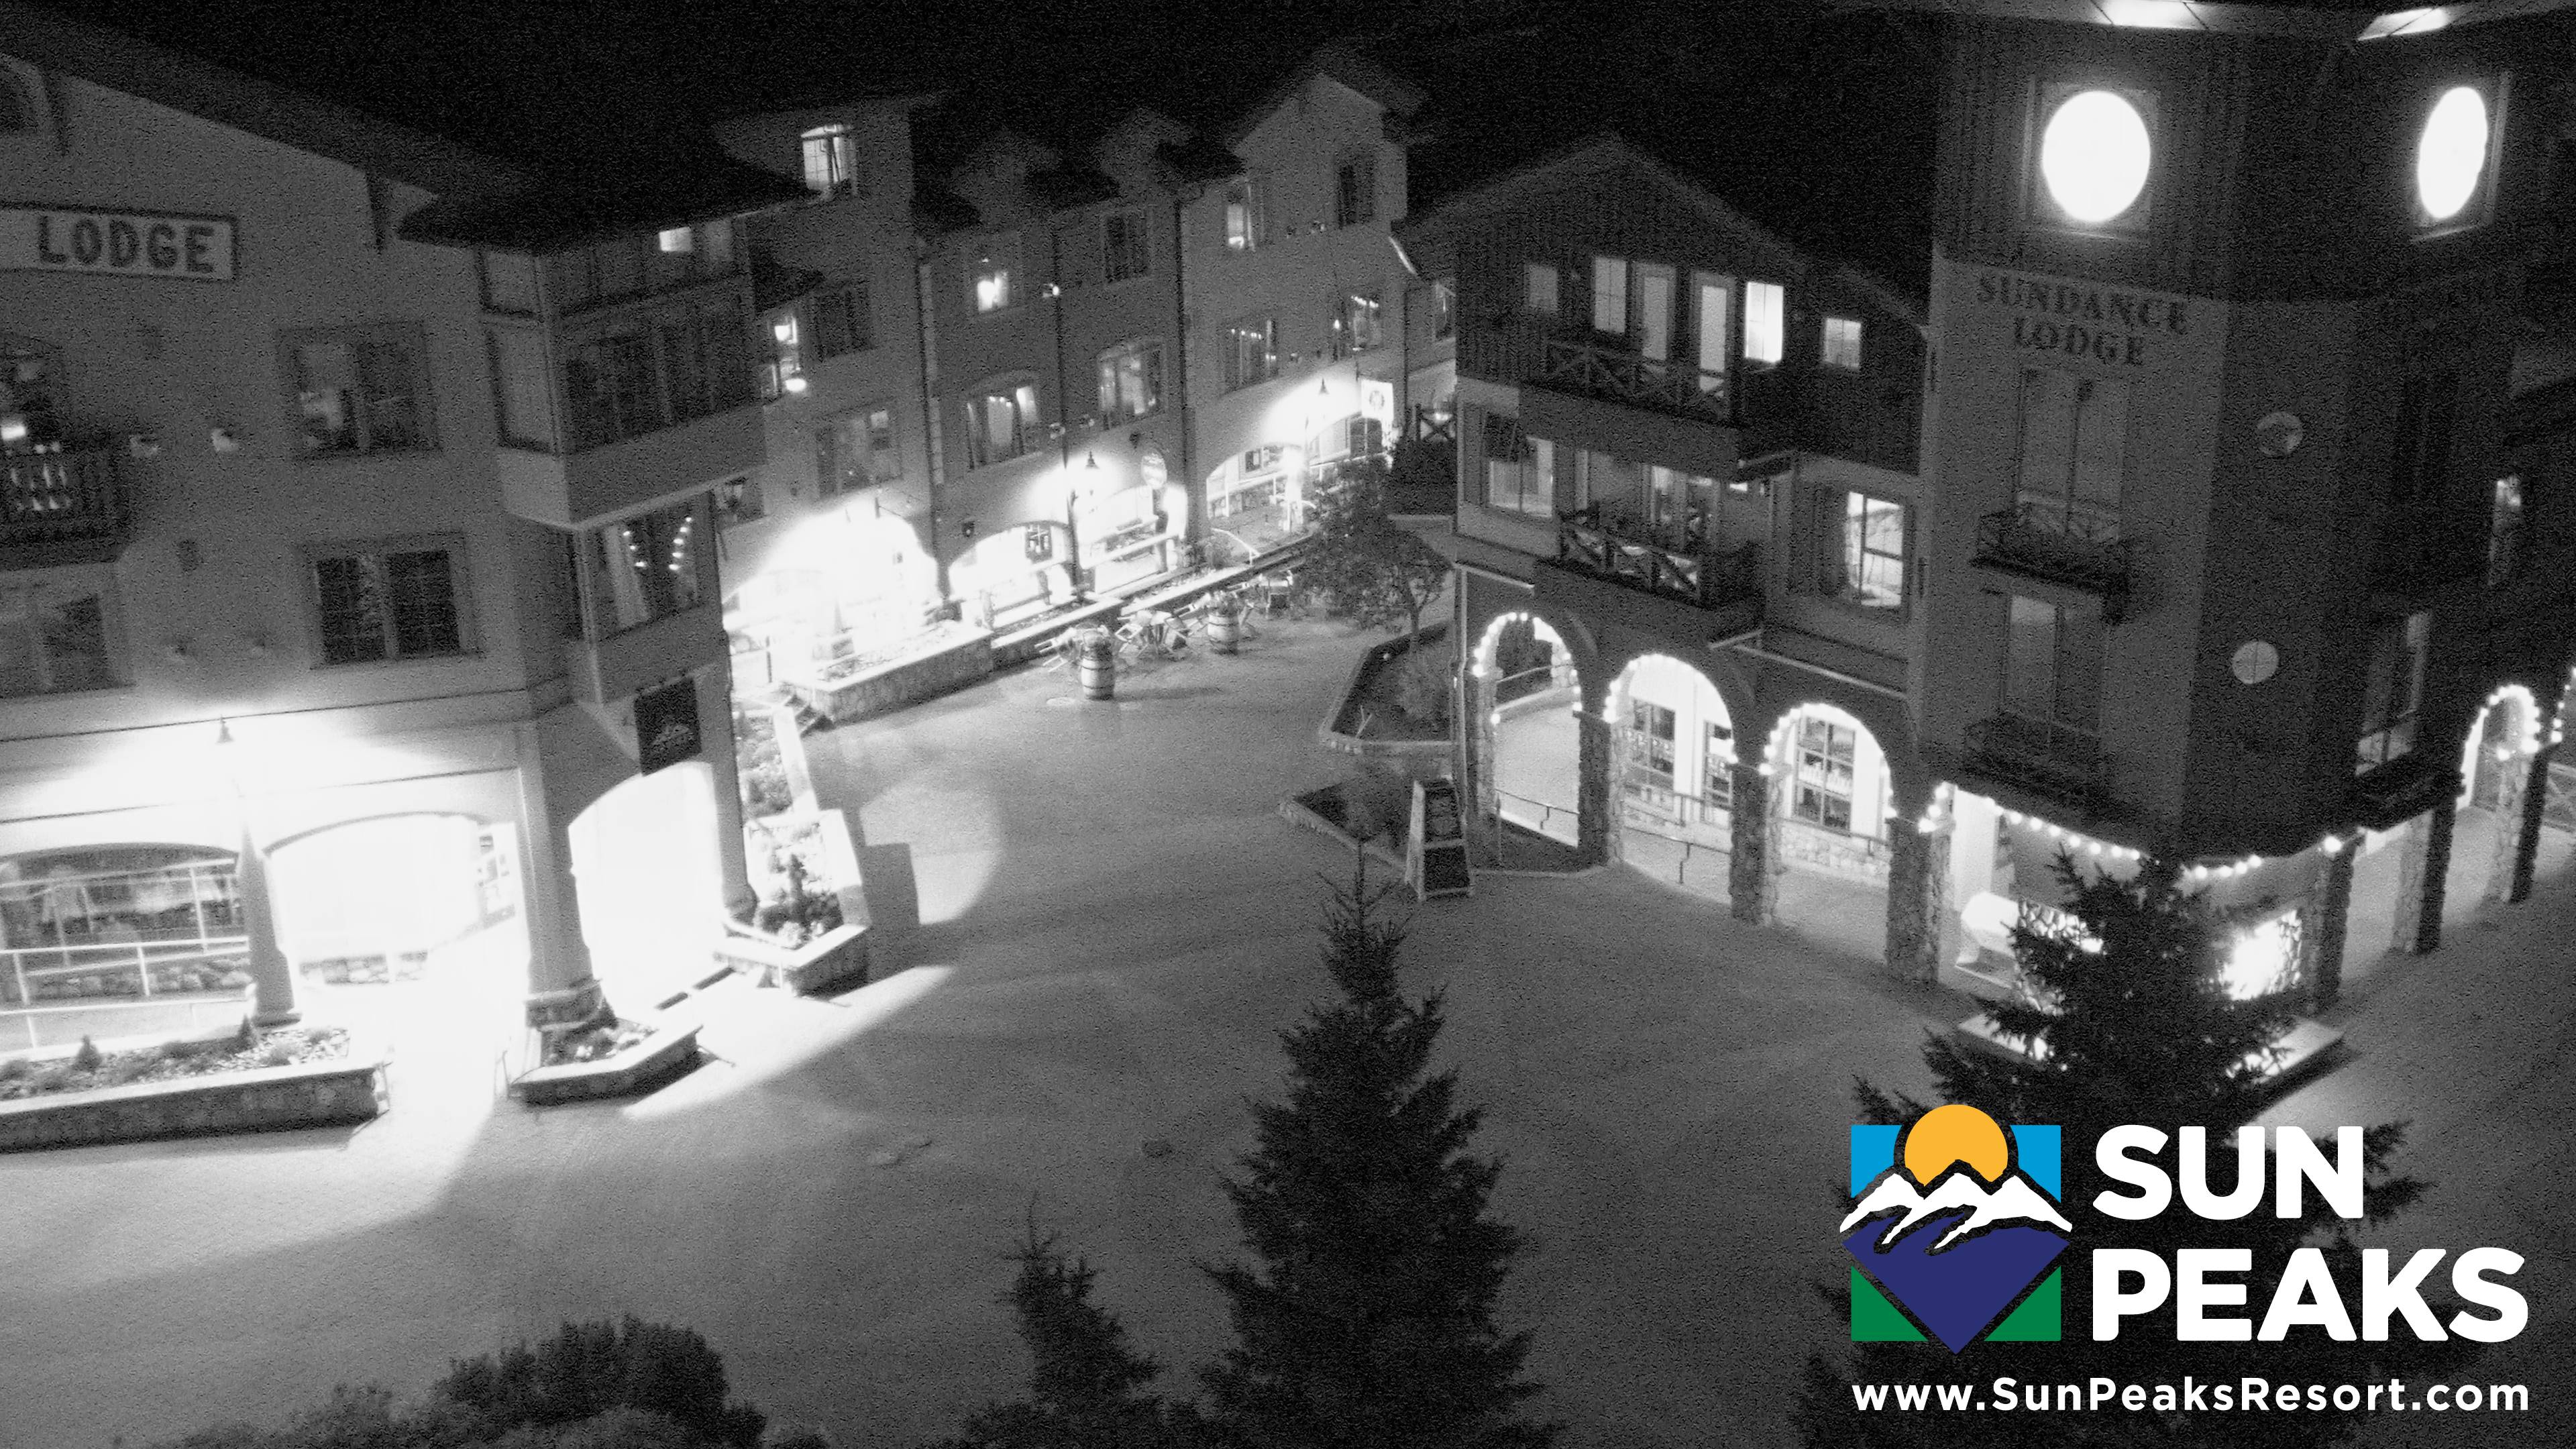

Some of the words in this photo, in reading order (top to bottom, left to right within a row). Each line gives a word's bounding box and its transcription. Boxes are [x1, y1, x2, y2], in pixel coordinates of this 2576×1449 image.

[38, 215, 215, 274] LODGE
[1976, 276, 2187, 335] SUNDANCE
[2014, 315, 2144, 368] LODGE
